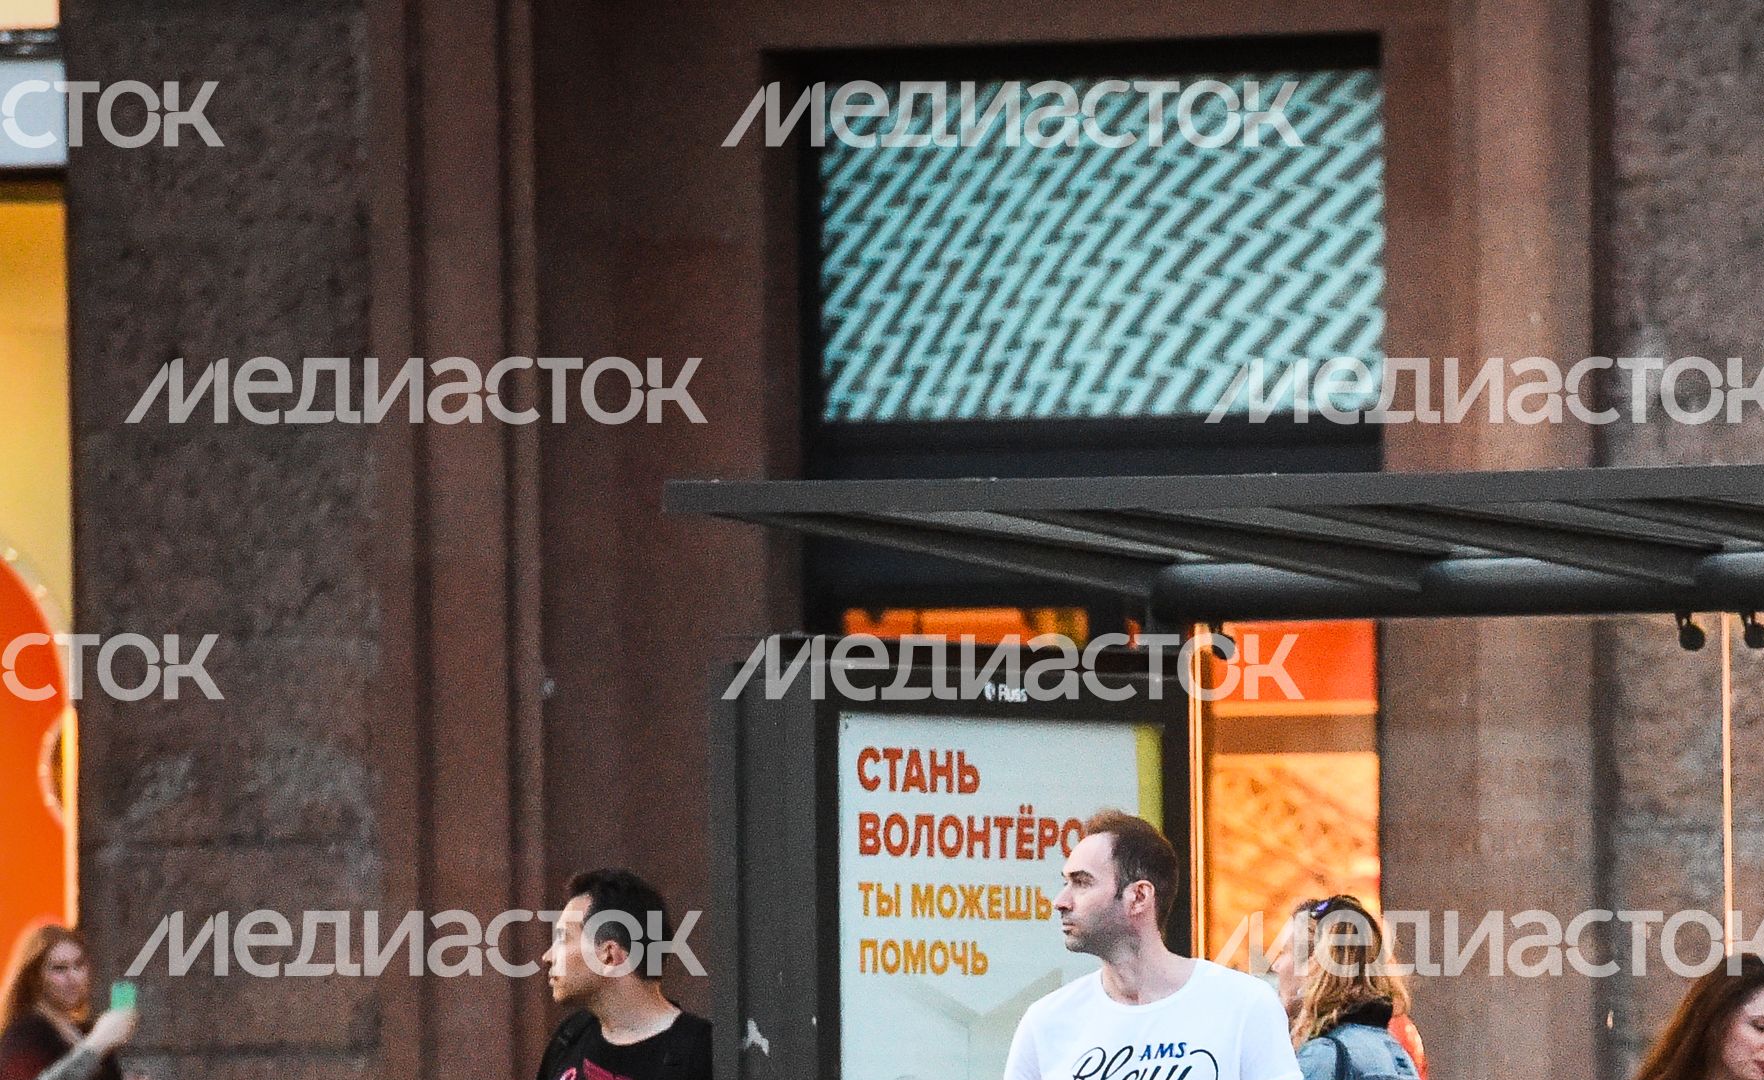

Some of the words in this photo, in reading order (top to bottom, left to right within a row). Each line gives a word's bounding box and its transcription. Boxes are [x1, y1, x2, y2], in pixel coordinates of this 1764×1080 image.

[857, 746, 981, 793] СТАНЬ
[858, 804, 1086, 860] ВОЛОНТЁРО
[858, 882, 901, 918] ТЫ
[911, 883, 1053, 921] МОЖЕШЬ
[859, 938, 989, 976] ПОМОЧЬ
[1139, 1041, 1187, 1062] AMS
